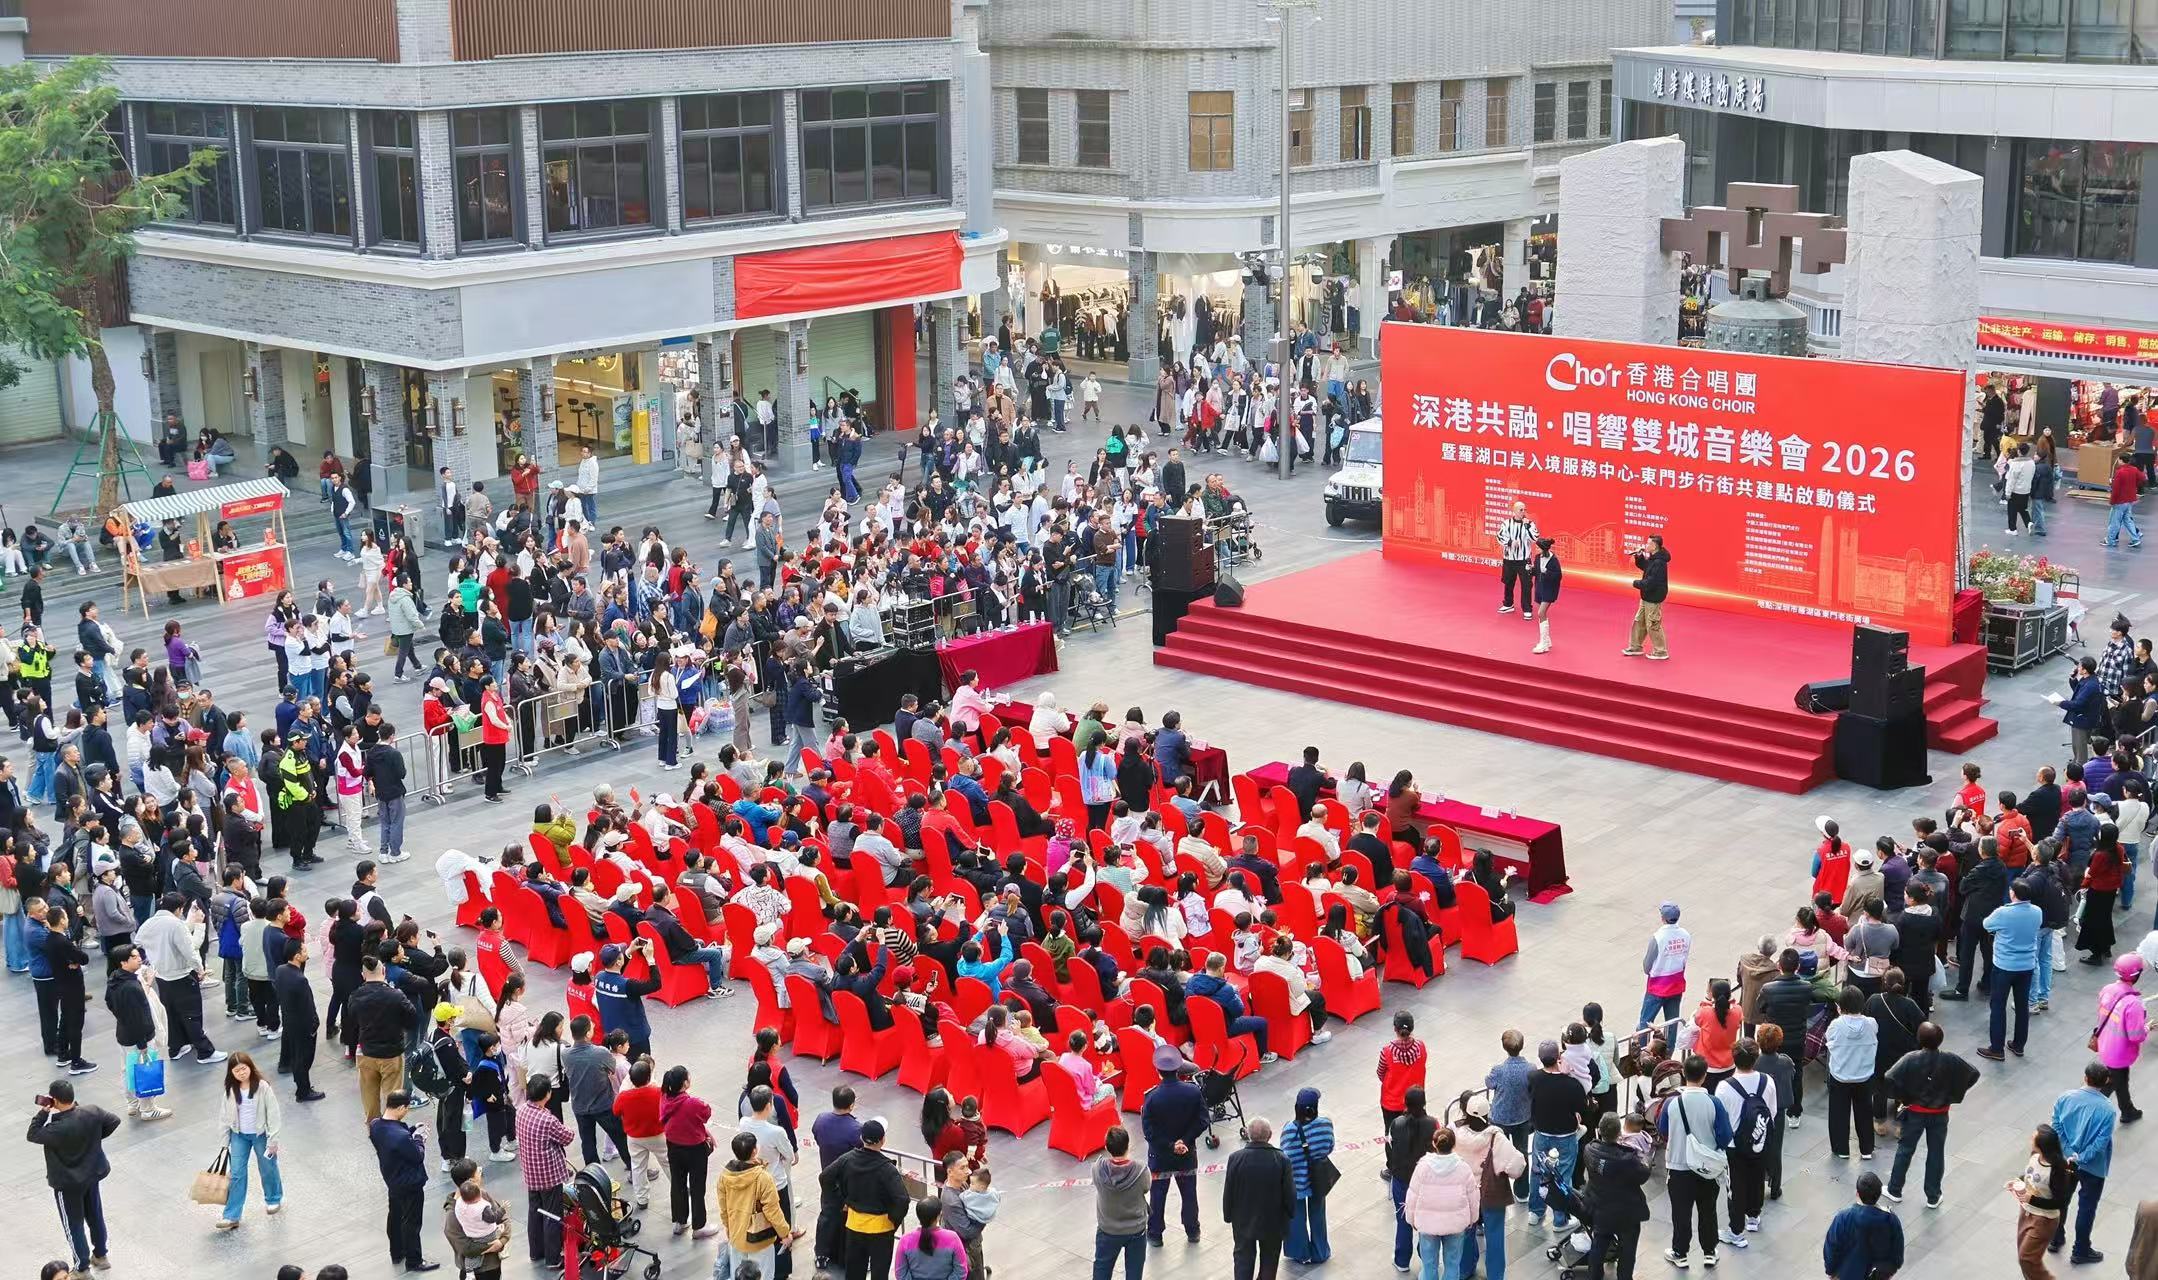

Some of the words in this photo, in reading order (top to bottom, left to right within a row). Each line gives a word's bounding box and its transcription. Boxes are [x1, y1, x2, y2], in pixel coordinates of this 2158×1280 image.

[1545, 352, 1622, 392] Choir
[1626, 362, 1756, 397] 香港合唱團
[1627, 390, 1665, 405] HONG
[1669, 394, 1708, 410] KONG
[1712, 399, 1756, 414] CHOIR
[1821, 440, 1916, 482] 2026
